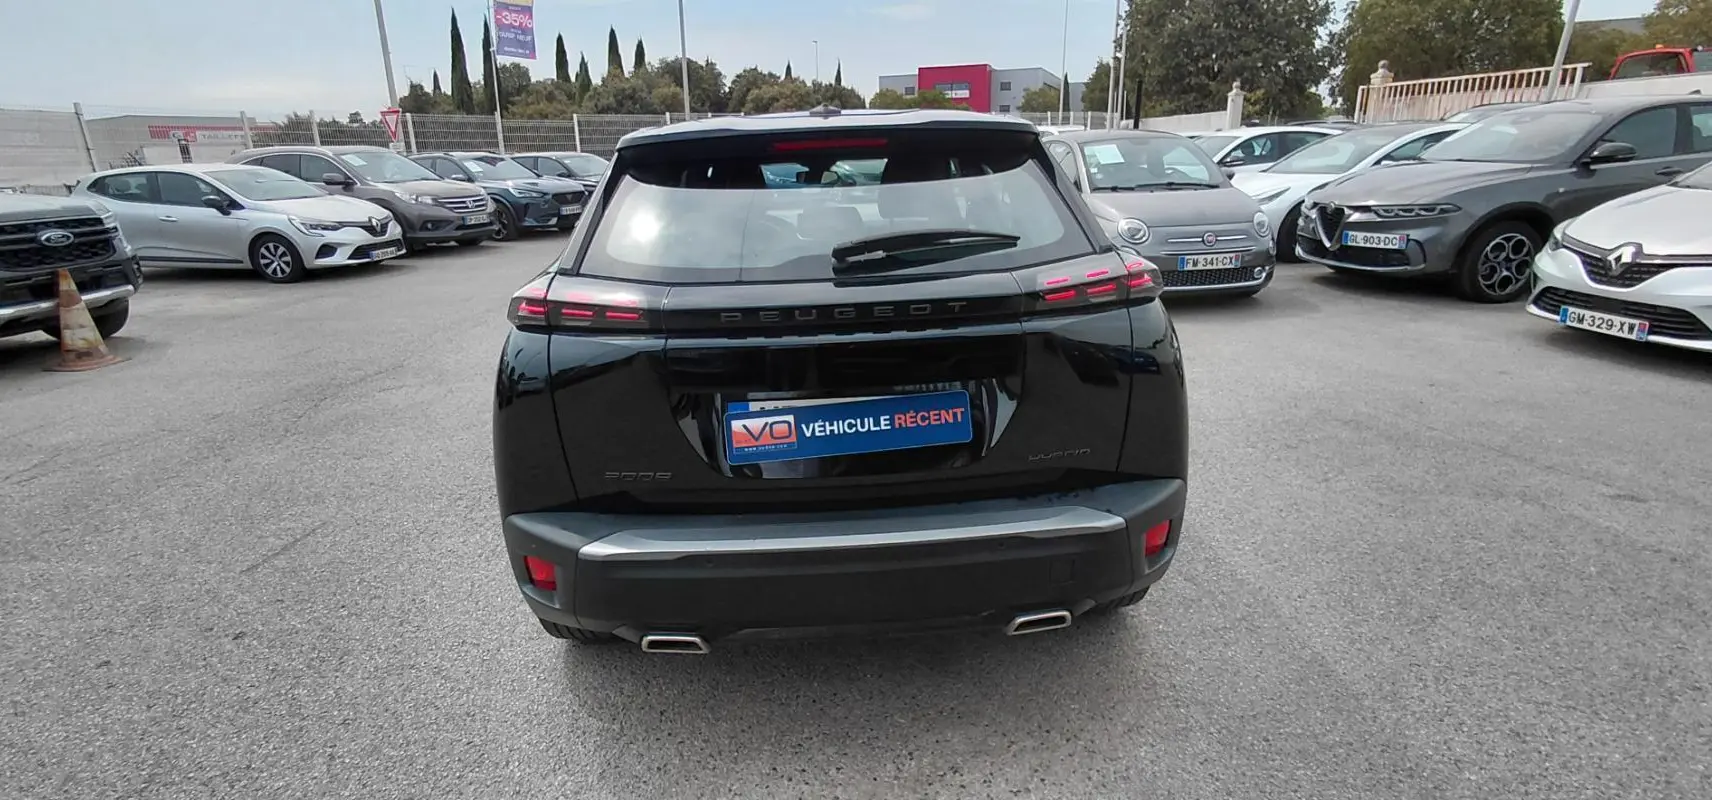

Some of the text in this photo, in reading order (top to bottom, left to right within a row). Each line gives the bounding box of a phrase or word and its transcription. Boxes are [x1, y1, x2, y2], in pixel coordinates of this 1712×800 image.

[496, 12, 532, 28] -35%
[1349, 233, 1397, 246] GL-903-DC
[1186, 256, 1234, 268] FM-341-CX
[720, 301, 967, 323] PEUGEOT
[1568, 311, 1636, 335] GM-329-XW
[742, 420, 792, 442] VO
[802, 407, 965, 438] VÉHICULE RÉCENT
